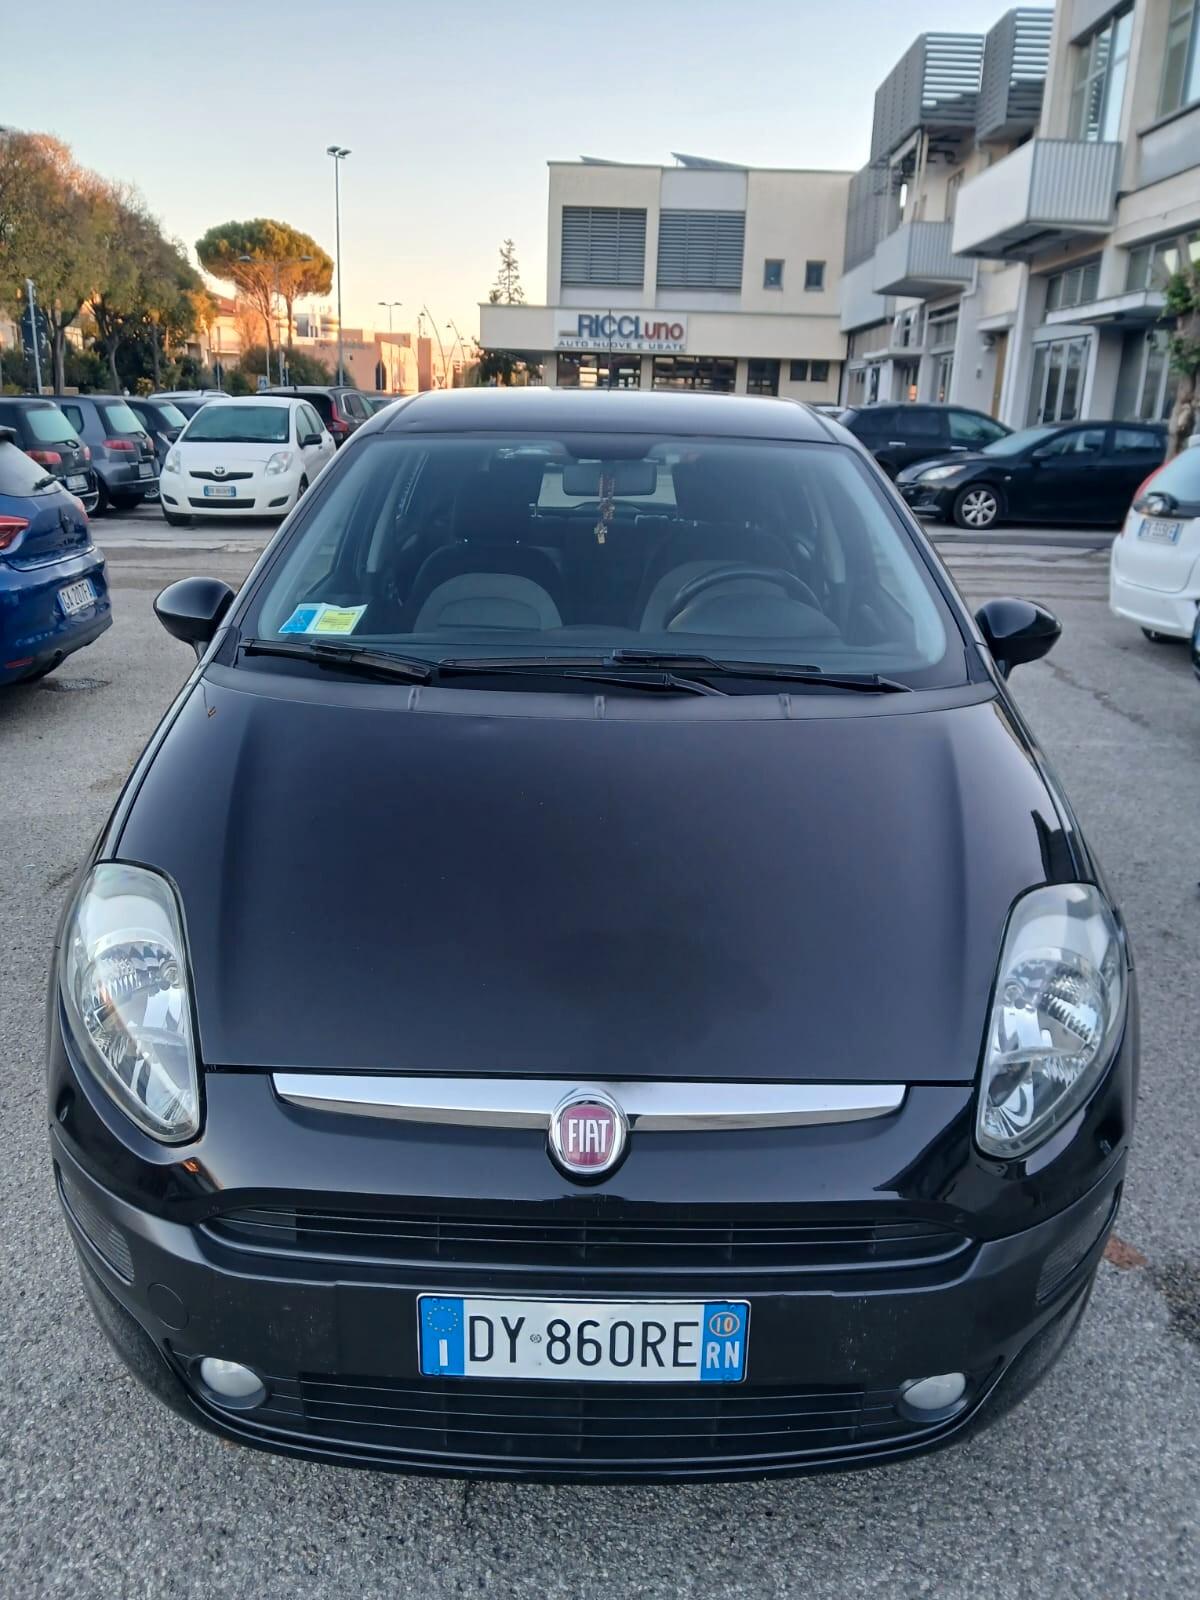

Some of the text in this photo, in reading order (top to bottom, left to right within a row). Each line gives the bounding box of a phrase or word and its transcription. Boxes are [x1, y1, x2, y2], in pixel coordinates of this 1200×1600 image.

[559, 340, 589, 348] AUTO
[593, 341, 630, 350] NUOVE
[568, 1119, 610, 1153] FIAT
[716, 1316, 734, 1333] 10
[469, 1315, 526, 1364] DY
[706, 1341, 740, 1369] RN
